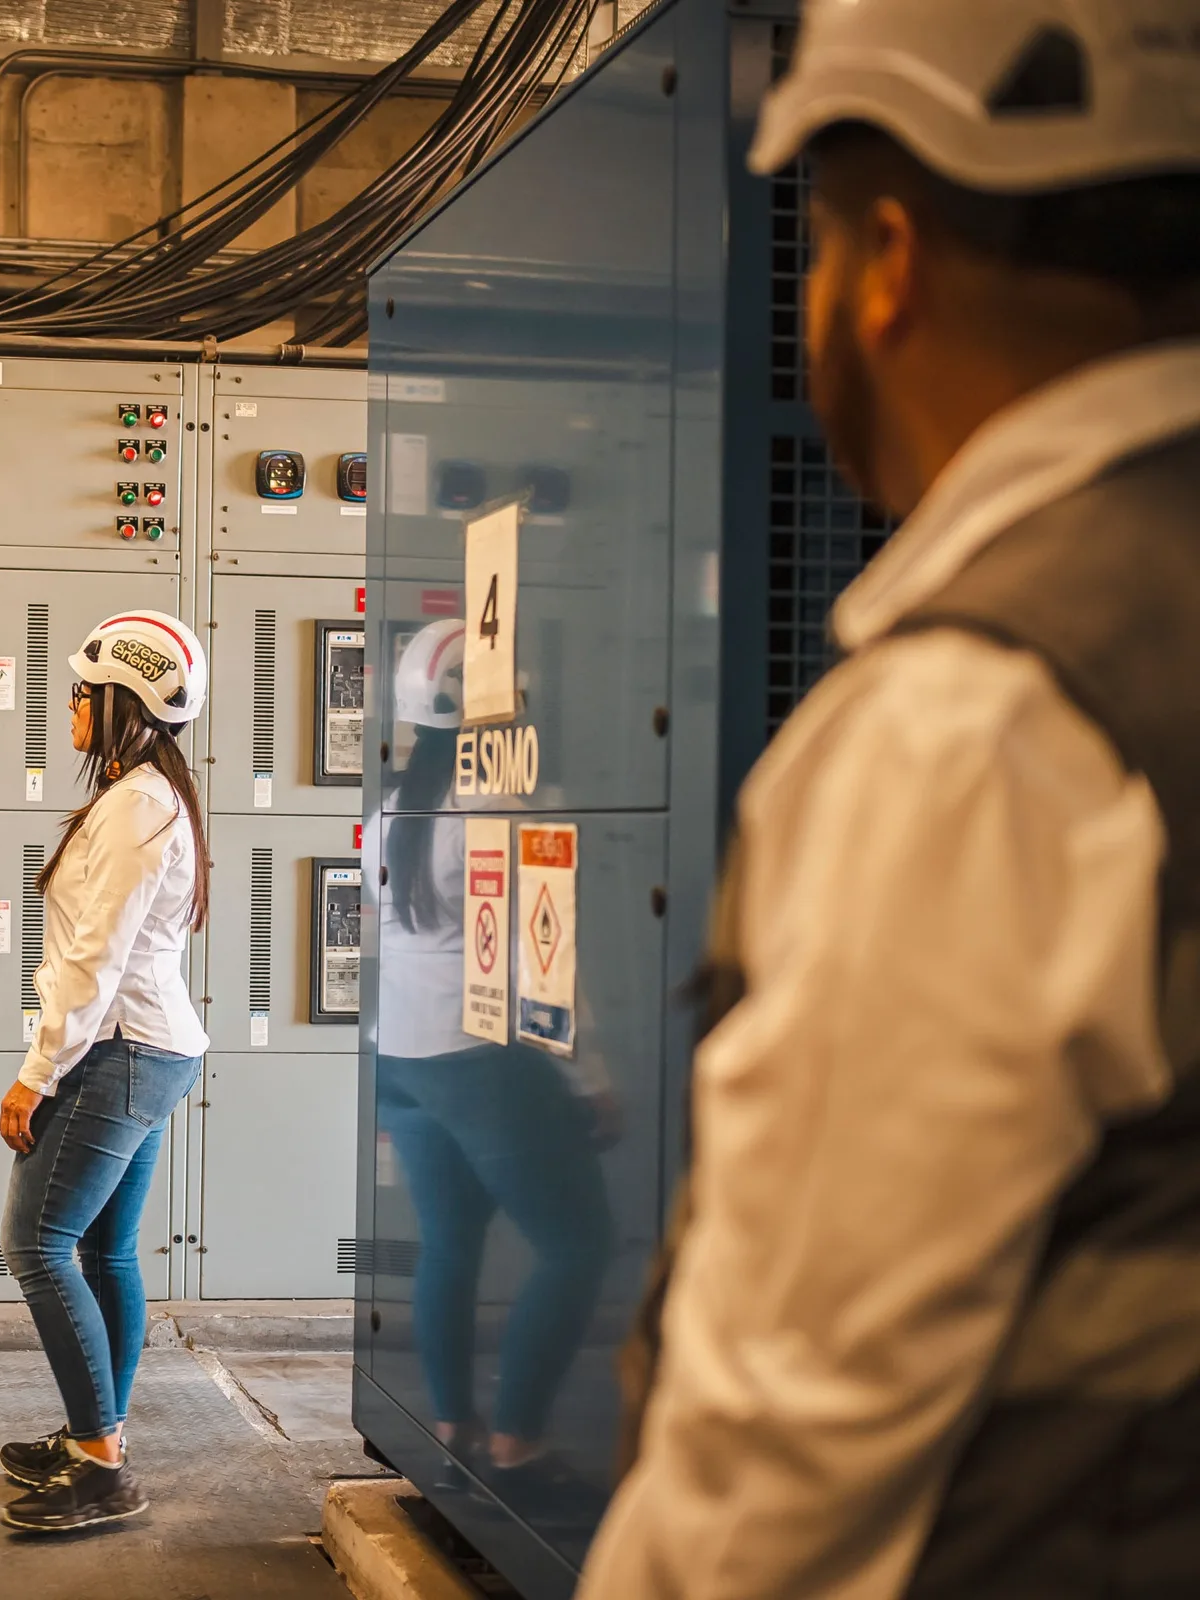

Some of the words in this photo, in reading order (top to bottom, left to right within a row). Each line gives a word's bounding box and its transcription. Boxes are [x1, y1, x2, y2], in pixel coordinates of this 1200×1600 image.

[480, 573, 498, 649] 4
[113, 644, 164, 680] energy
[128, 640, 169, 669] green
[479, 725, 538, 795] SDMO
